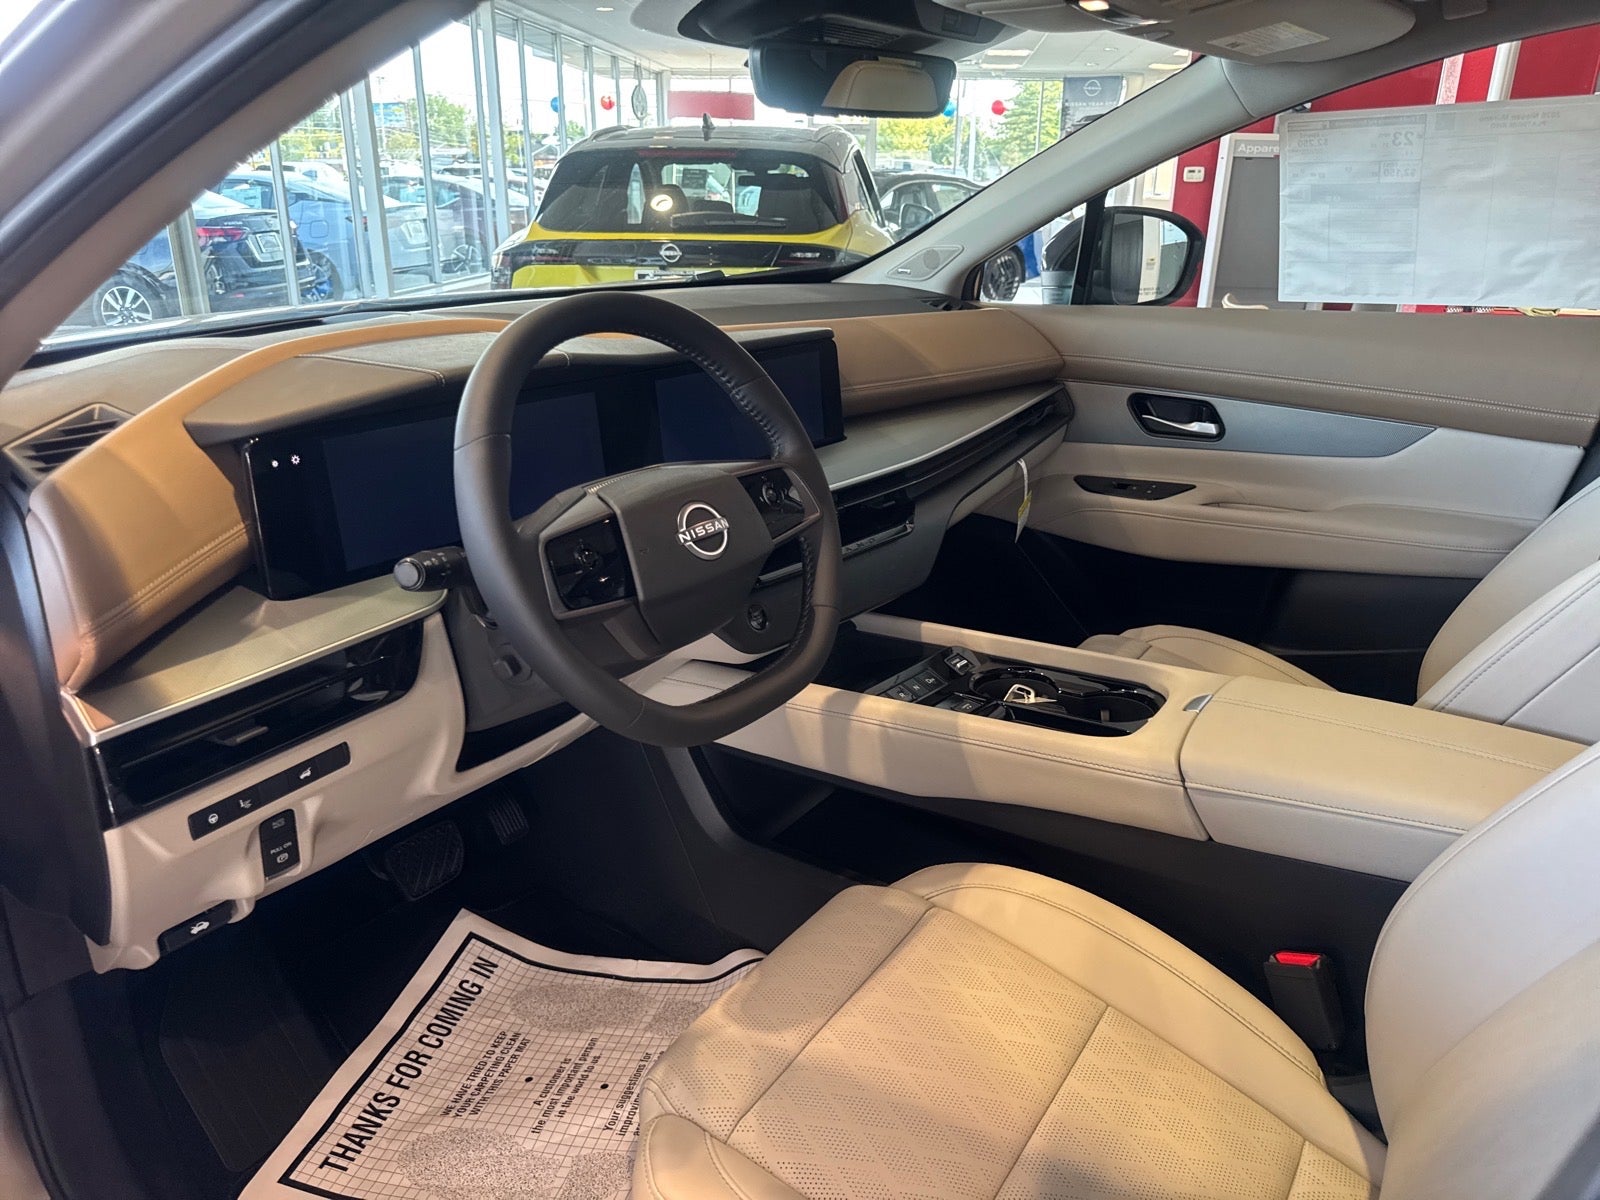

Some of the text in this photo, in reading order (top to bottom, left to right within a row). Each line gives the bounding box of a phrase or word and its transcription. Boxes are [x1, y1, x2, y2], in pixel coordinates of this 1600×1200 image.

[678, 520, 729, 543] NISSAN
[270, 846, 283, 854] PULL
[319, 956, 499, 1172] THANKS FOR COMING IN
[440, 1031, 508, 1116] WE HAVE TRIED TO KEEP
[452, 1032, 522, 1118] YOUR CARPETING CLEAN
[469, 1038, 531, 1116] WITH THIS PAPER MAT
[531, 1037, 599, 1134] the most important person
[533, 1098, 543, 1106] A
[539, 1065, 568, 1098] customer
[554, 1110, 564, 1118] in
[561, 1095, 575, 1110] the
[571, 1074, 590, 1095] world
[584, 1065, 595, 1073] to
[603, 1052, 652, 1130] Your suggestions for
[616, 1093, 640, 1136] improvin
